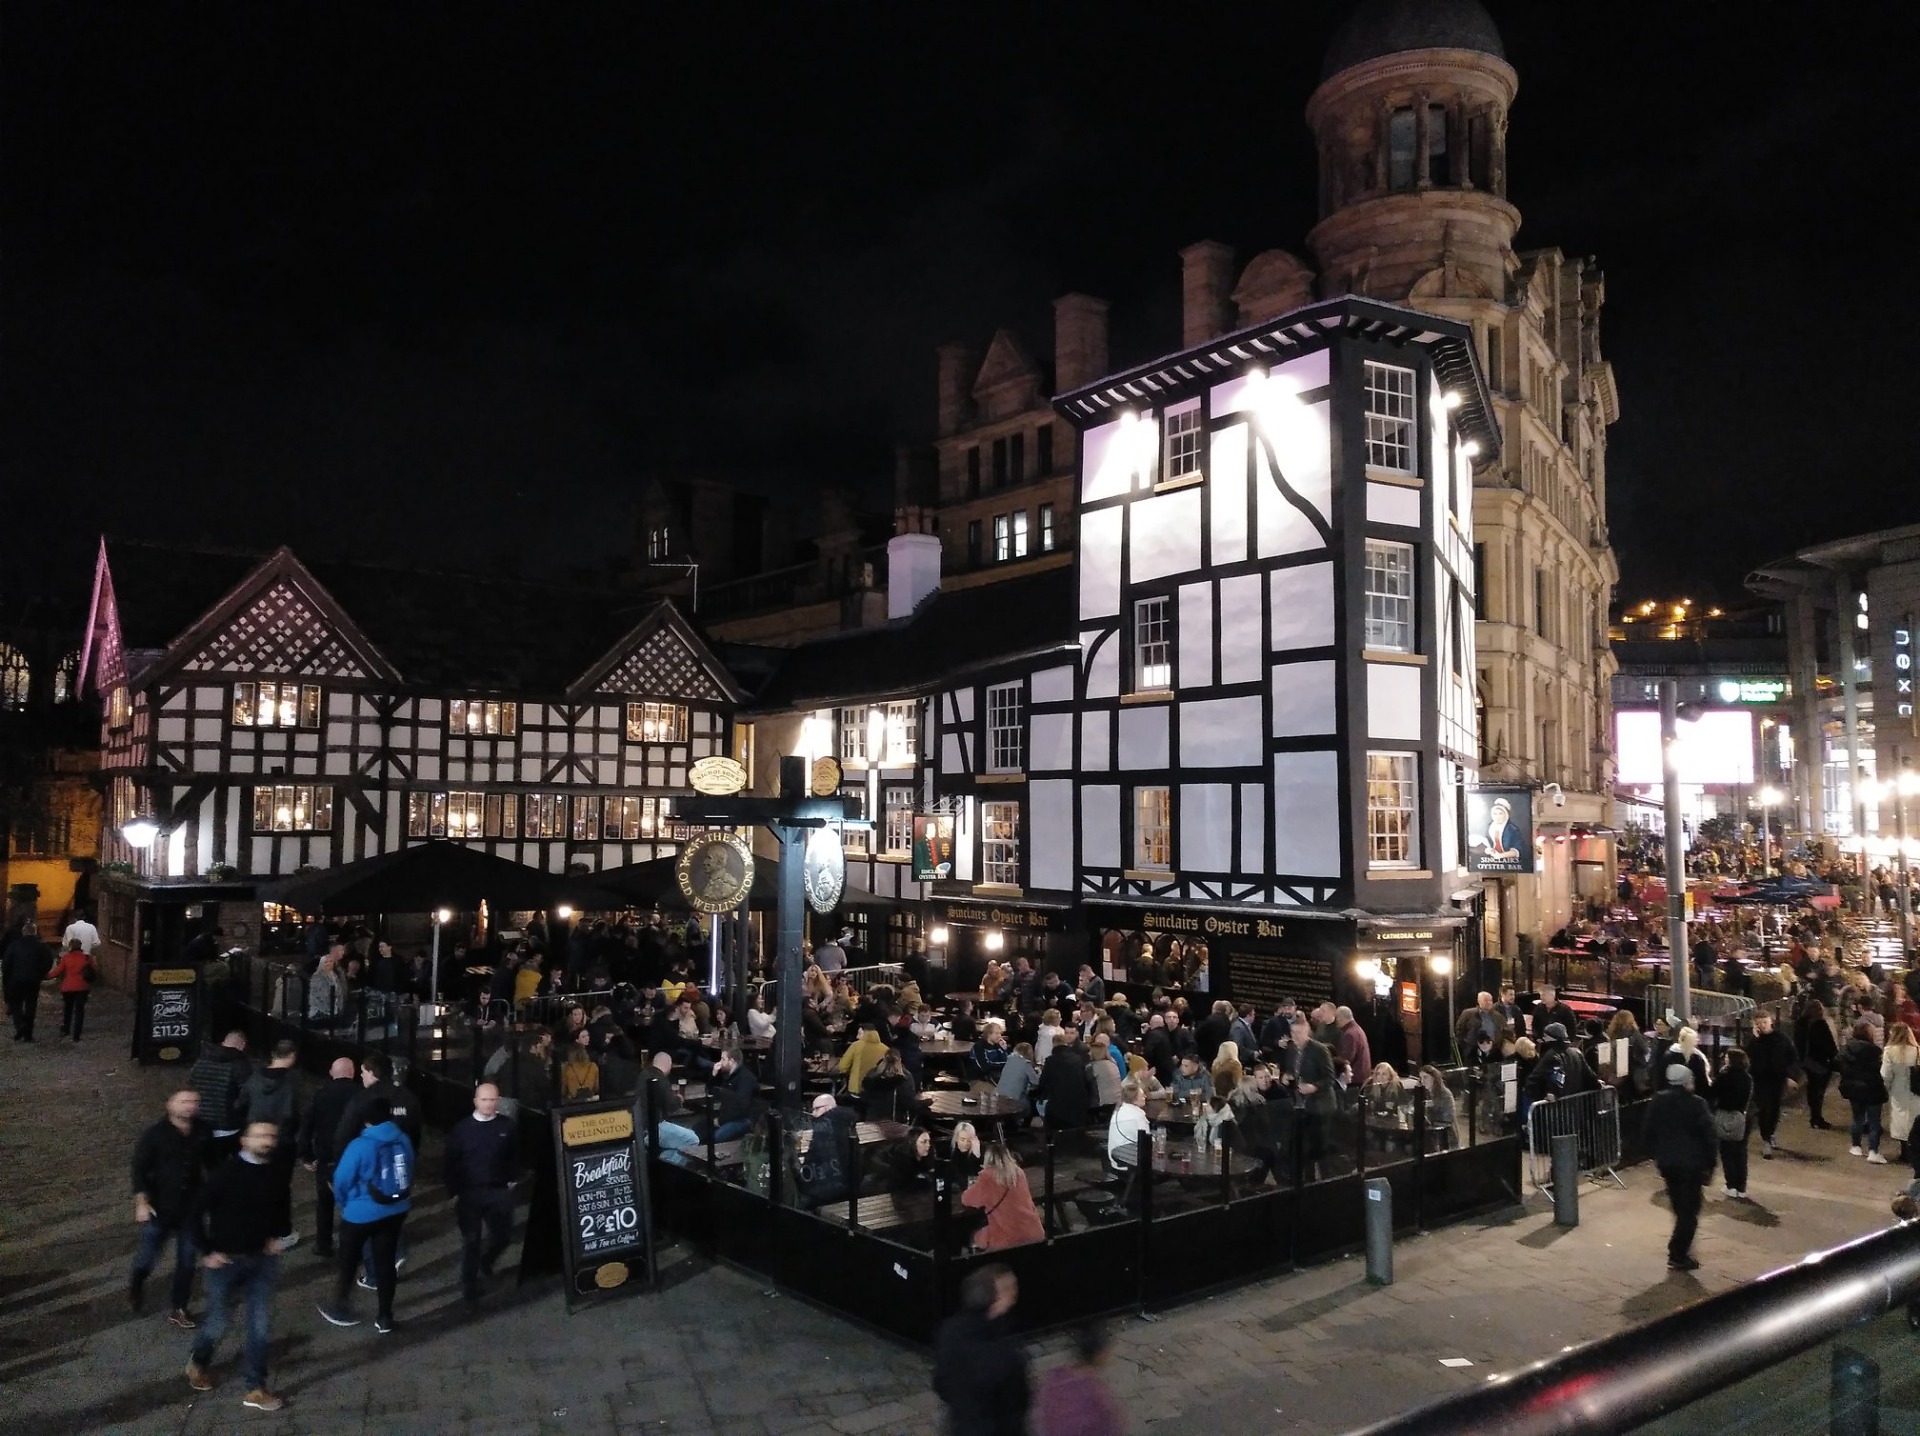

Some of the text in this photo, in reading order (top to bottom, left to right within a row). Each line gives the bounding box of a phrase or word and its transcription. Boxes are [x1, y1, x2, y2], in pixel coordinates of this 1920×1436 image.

[1895, 630, 1913, 716] next
[705, 832, 731, 842] THE
[679, 871, 753, 912] OLD WELLINGTON
[947, 905, 1048, 926] Sinclairs Oyster Bar
[1143, 912, 1285, 938] Sinclairs Oyster Bar
[1382, 932, 1415, 940] CATHEDRAL
[152, 998, 190, 1018] Roast
[567, 1124, 629, 1140] WELLINGTON
[581, 1117, 615, 1128] THE OLD
[573, 1147, 631, 1188] Breakfast
[578, 1203, 590, 1213] SAT
[597, 1200, 610, 1210] SUN
[580, 1215, 595, 1238] 2
[604, 1207, 637, 1233] £10
